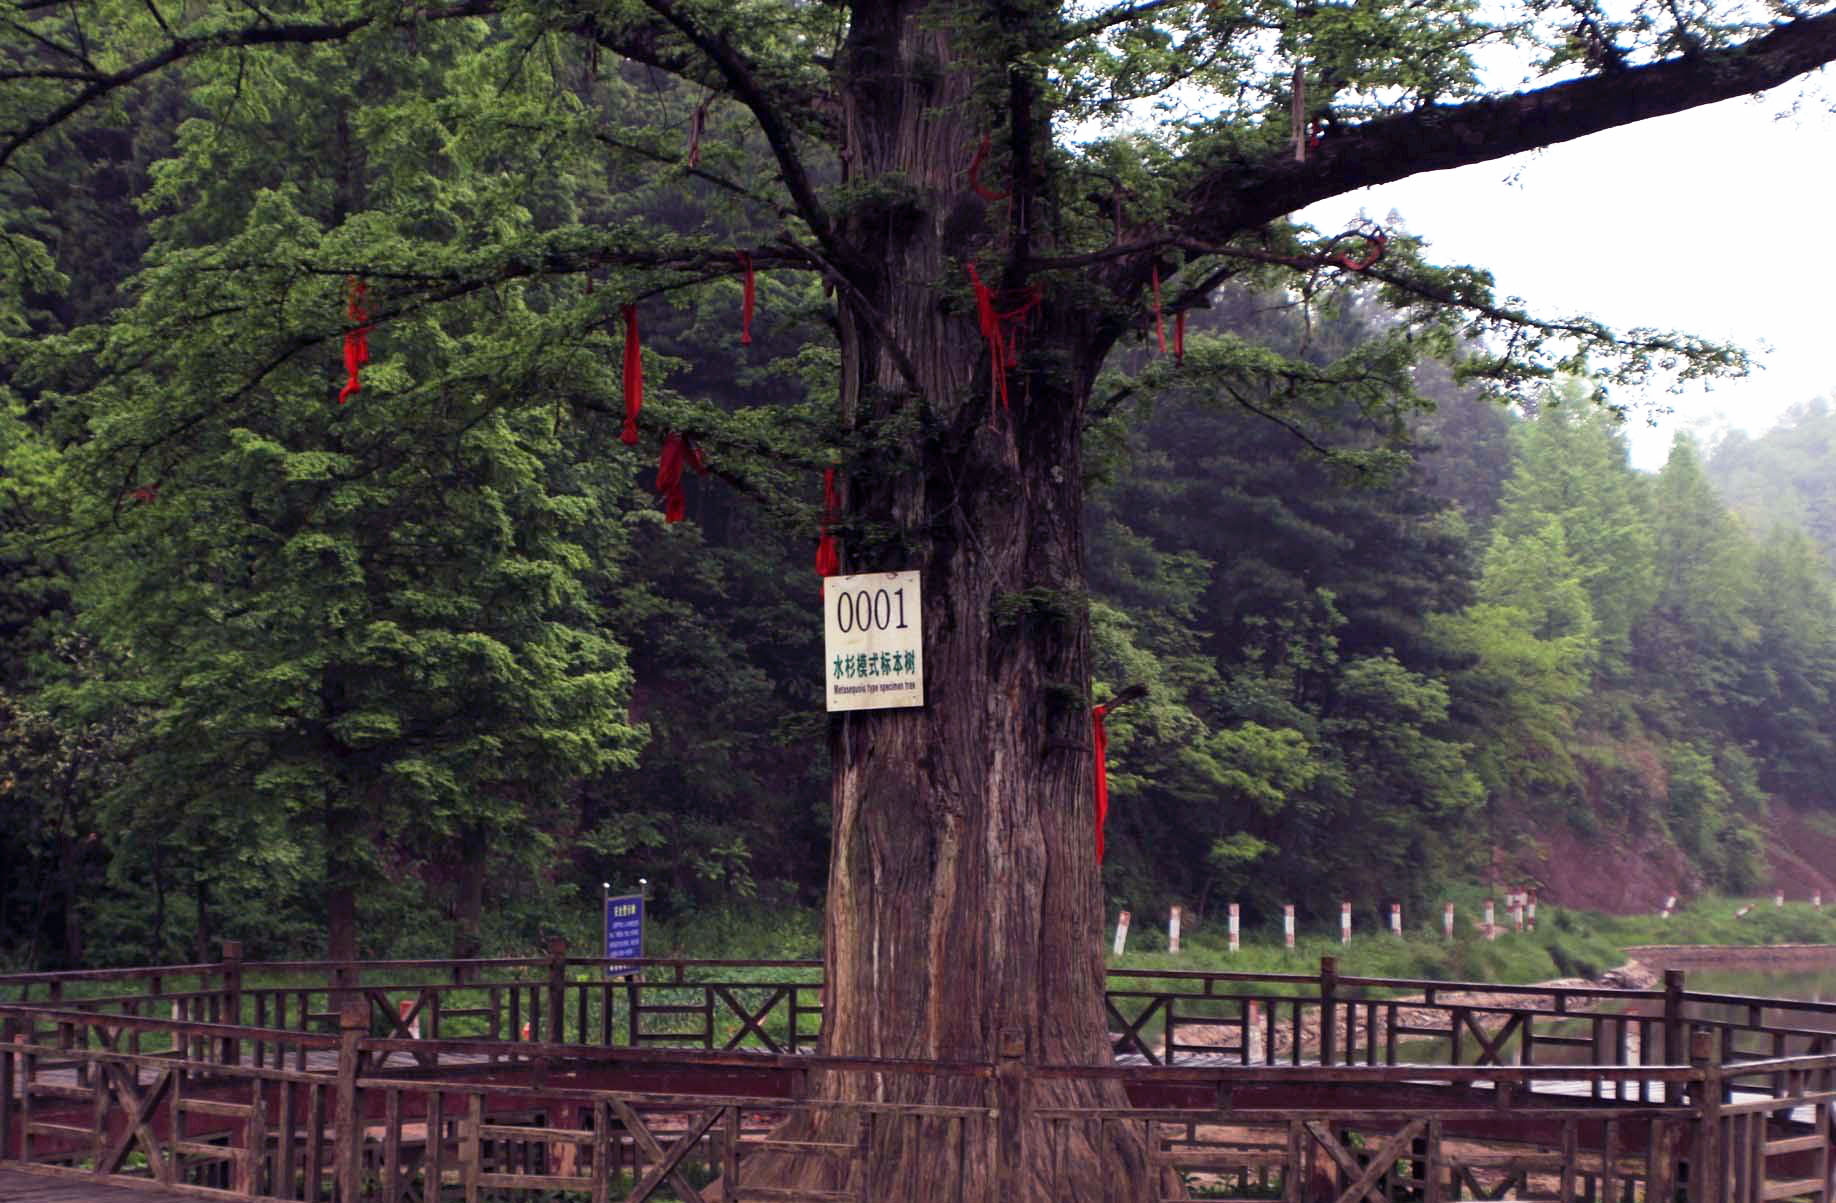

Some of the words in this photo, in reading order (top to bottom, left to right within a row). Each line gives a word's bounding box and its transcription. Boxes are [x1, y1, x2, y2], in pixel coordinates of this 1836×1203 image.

[837, 588, 908, 633] 0001
[833, 649, 915, 680] 水杉模式标本树
[867, 683, 878, 694] type
